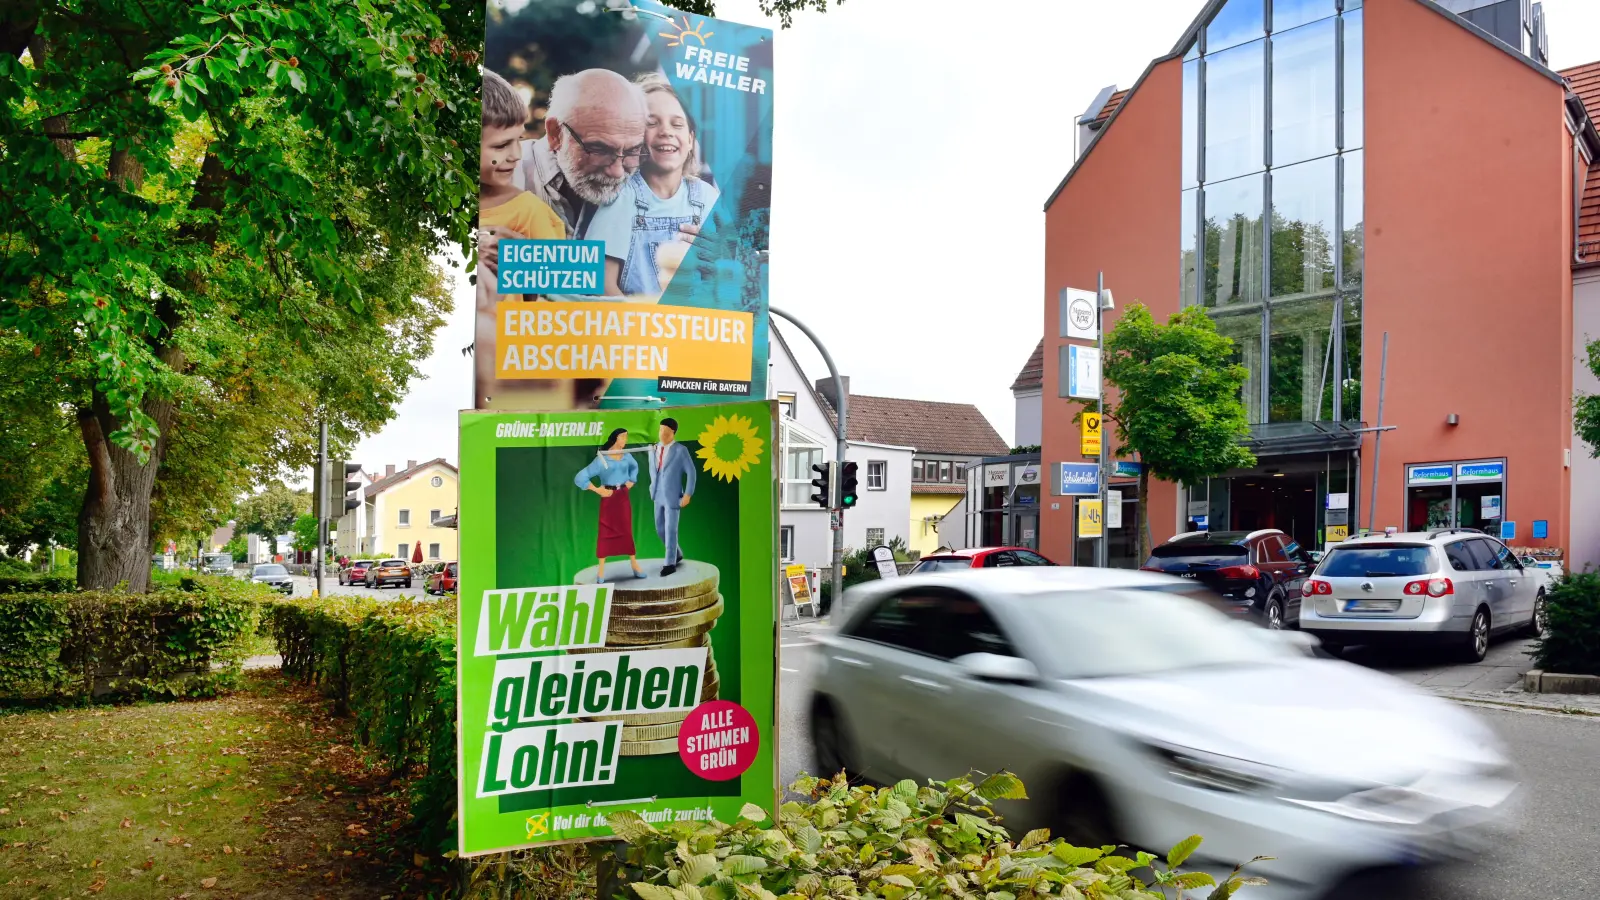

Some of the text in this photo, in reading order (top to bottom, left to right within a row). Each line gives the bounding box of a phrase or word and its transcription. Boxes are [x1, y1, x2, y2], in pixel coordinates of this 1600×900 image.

[684, 45, 750, 72] FREIE
[675, 62, 767, 95] WÄHLER
[502, 244, 600, 264] EIGENTUM
[502, 265, 597, 289] SCHÜTZEN
[504, 309, 746, 345] ERBSCHAFTSSTEUER
[502, 344, 669, 372] ABSCHAFFEN
[660, 379, 748, 393] ANPACKEN FÜR BAYERN
[495, 420, 605, 438] GRÜNE-BAYERN.DE
[1414, 470, 1449, 479] Reformhaus
[1462, 467, 1499, 476] Reformhaus
[488, 586, 608, 651] Wähl
[491, 655, 700, 733] gleichen
[700, 708, 734, 732] ALLE
[686, 726, 750, 754] STIMMEN
[482, 724, 618, 794] Lohn!
[700, 747, 737, 771] GRÜN
[553, 814, 573, 831] Hol
[574, 813, 592, 828] dir
[630, 807, 673, 824] kunft
[674, 806, 716, 822] zurück.
